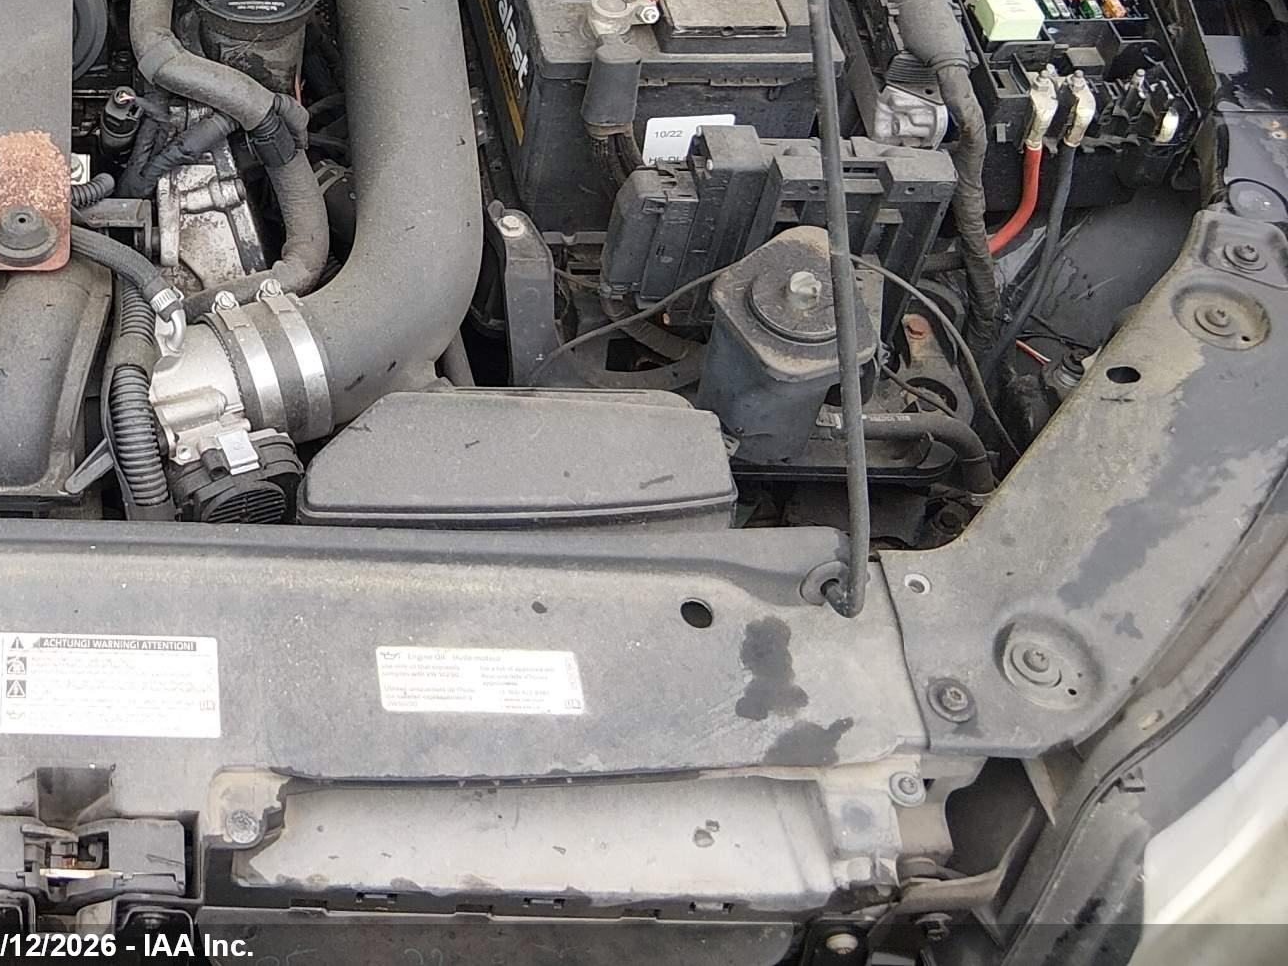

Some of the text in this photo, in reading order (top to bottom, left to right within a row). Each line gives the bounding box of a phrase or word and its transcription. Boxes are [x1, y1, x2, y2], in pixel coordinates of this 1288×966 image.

[654, 130, 683, 138] 10/22
[43, 638, 194, 651] ACHTUNG! WARNING! ATTENTION!
